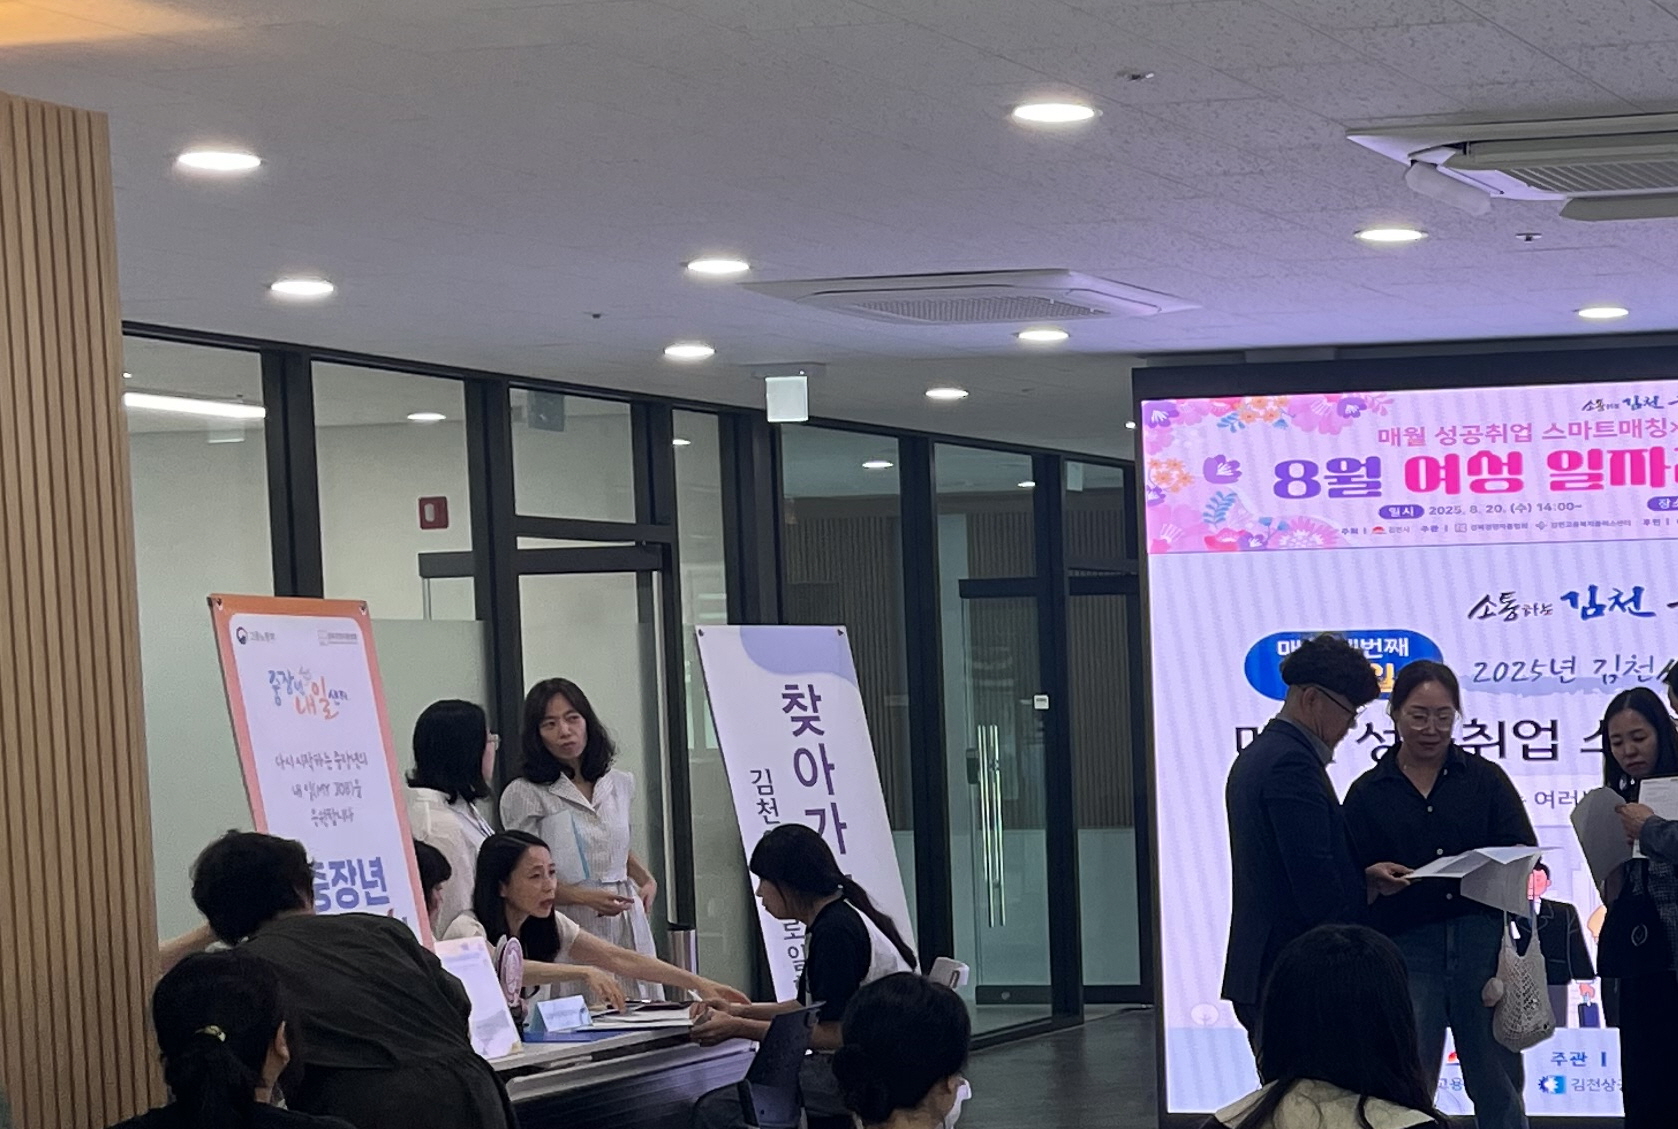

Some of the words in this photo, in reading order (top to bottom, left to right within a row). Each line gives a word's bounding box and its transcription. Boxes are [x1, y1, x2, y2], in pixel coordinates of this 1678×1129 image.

[1378, 427, 1427, 447] 매월
[1434, 422, 1533, 446] 성공취업
[1273, 455, 1382, 499] 8월
[1404, 450, 1524, 495] 여성
[1388, 506, 1415, 518] 일시
[1510, 502, 1533, 514] (수)
[1468, 591, 1554, 622] 소통하는
[1560, 584, 1657, 621] 김천
[1473, 655, 1576, 684] 2025년
[1593, 653, 1676, 685] 김천
[782, 684, 853, 880] 찾아가
[750, 768, 781, 835] 김천
[1551, 1051, 1588, 1067] 주관
